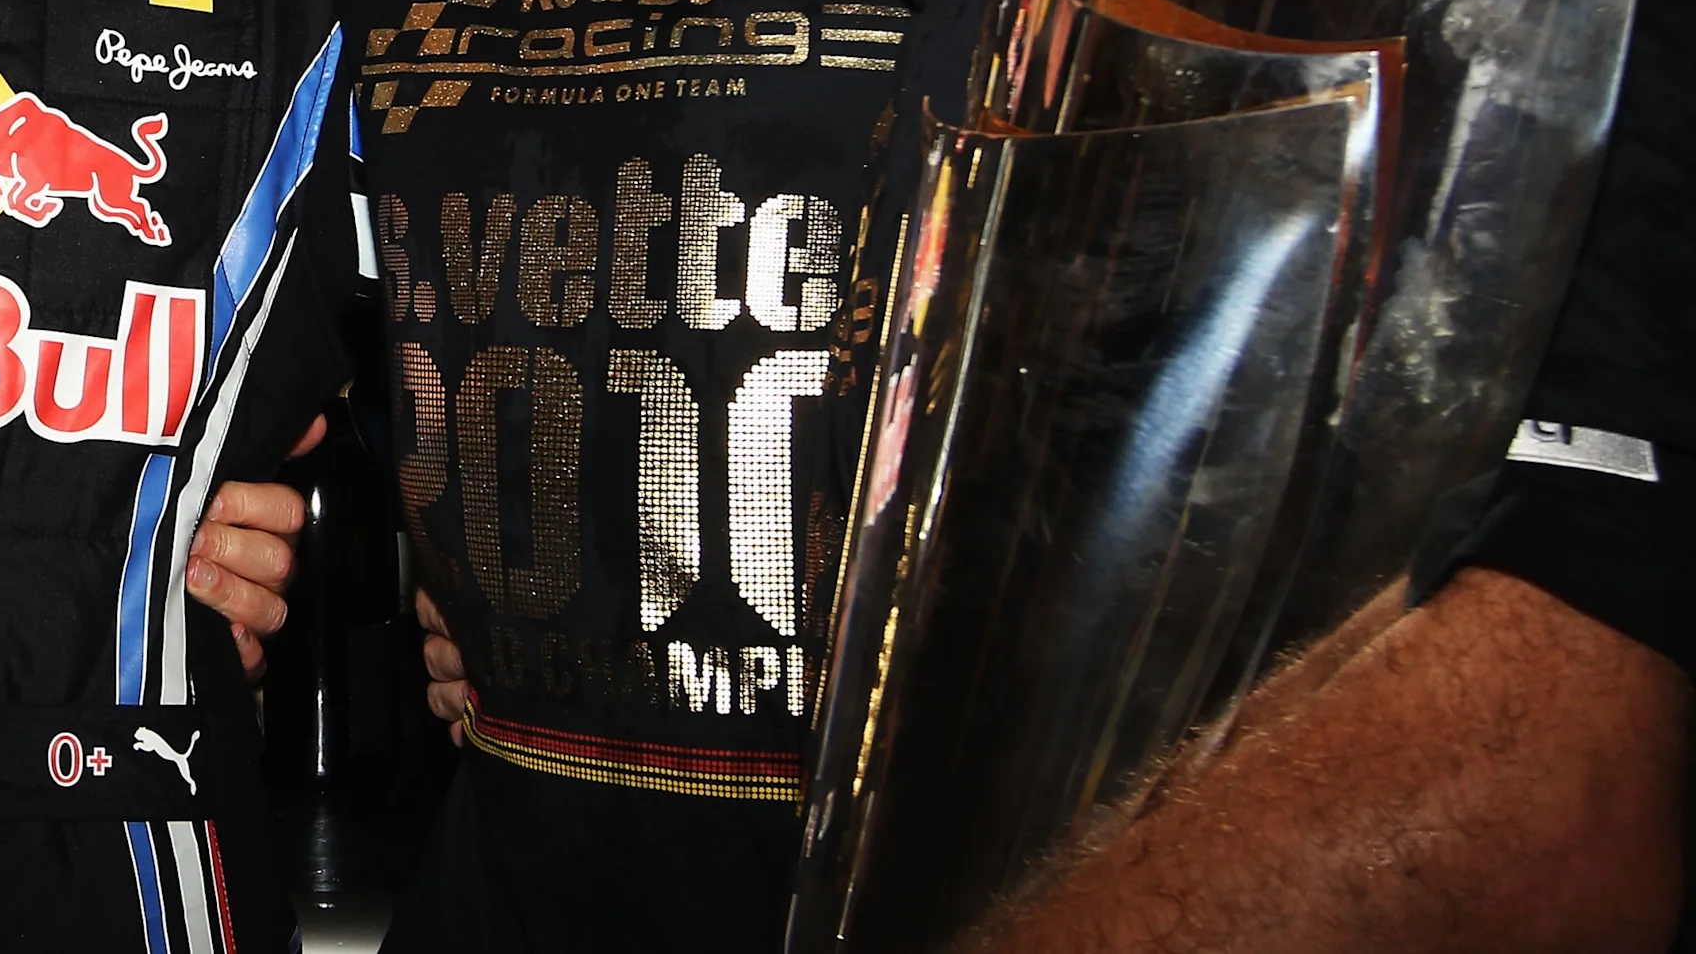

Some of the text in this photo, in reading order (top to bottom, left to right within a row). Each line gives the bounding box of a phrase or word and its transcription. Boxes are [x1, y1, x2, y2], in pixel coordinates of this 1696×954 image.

[95, 28, 258, 90] Pepe Jeans
[457, 9, 811, 71] racing
[491, 77, 747, 105] FORMULA ONE TEAM
[379, 152, 845, 333] s.vette
